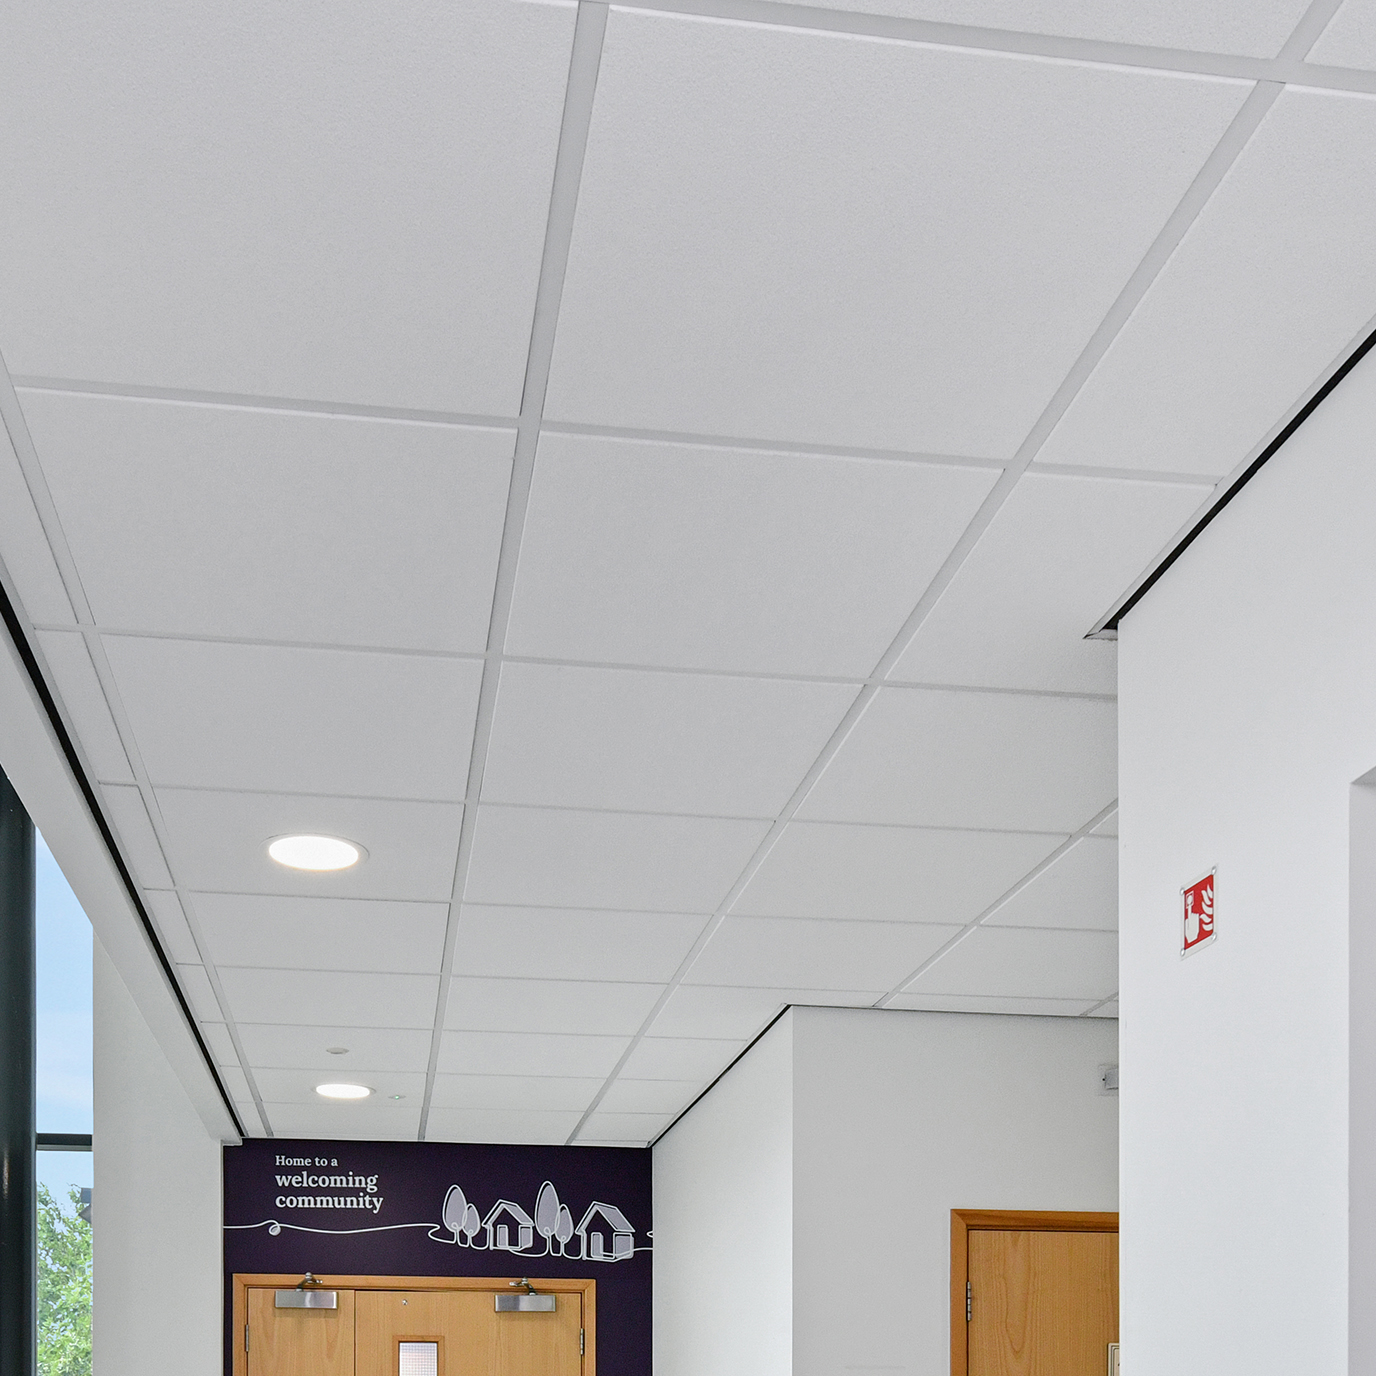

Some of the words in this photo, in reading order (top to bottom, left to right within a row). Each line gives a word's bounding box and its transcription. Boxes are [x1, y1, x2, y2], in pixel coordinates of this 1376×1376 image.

[275, 1155, 312, 1167] Home
[314, 1156, 328, 1167] to
[330, 1158, 339, 1167] a
[274, 1170, 379, 1193] welcoming
[275, 1192, 384, 1214] community
